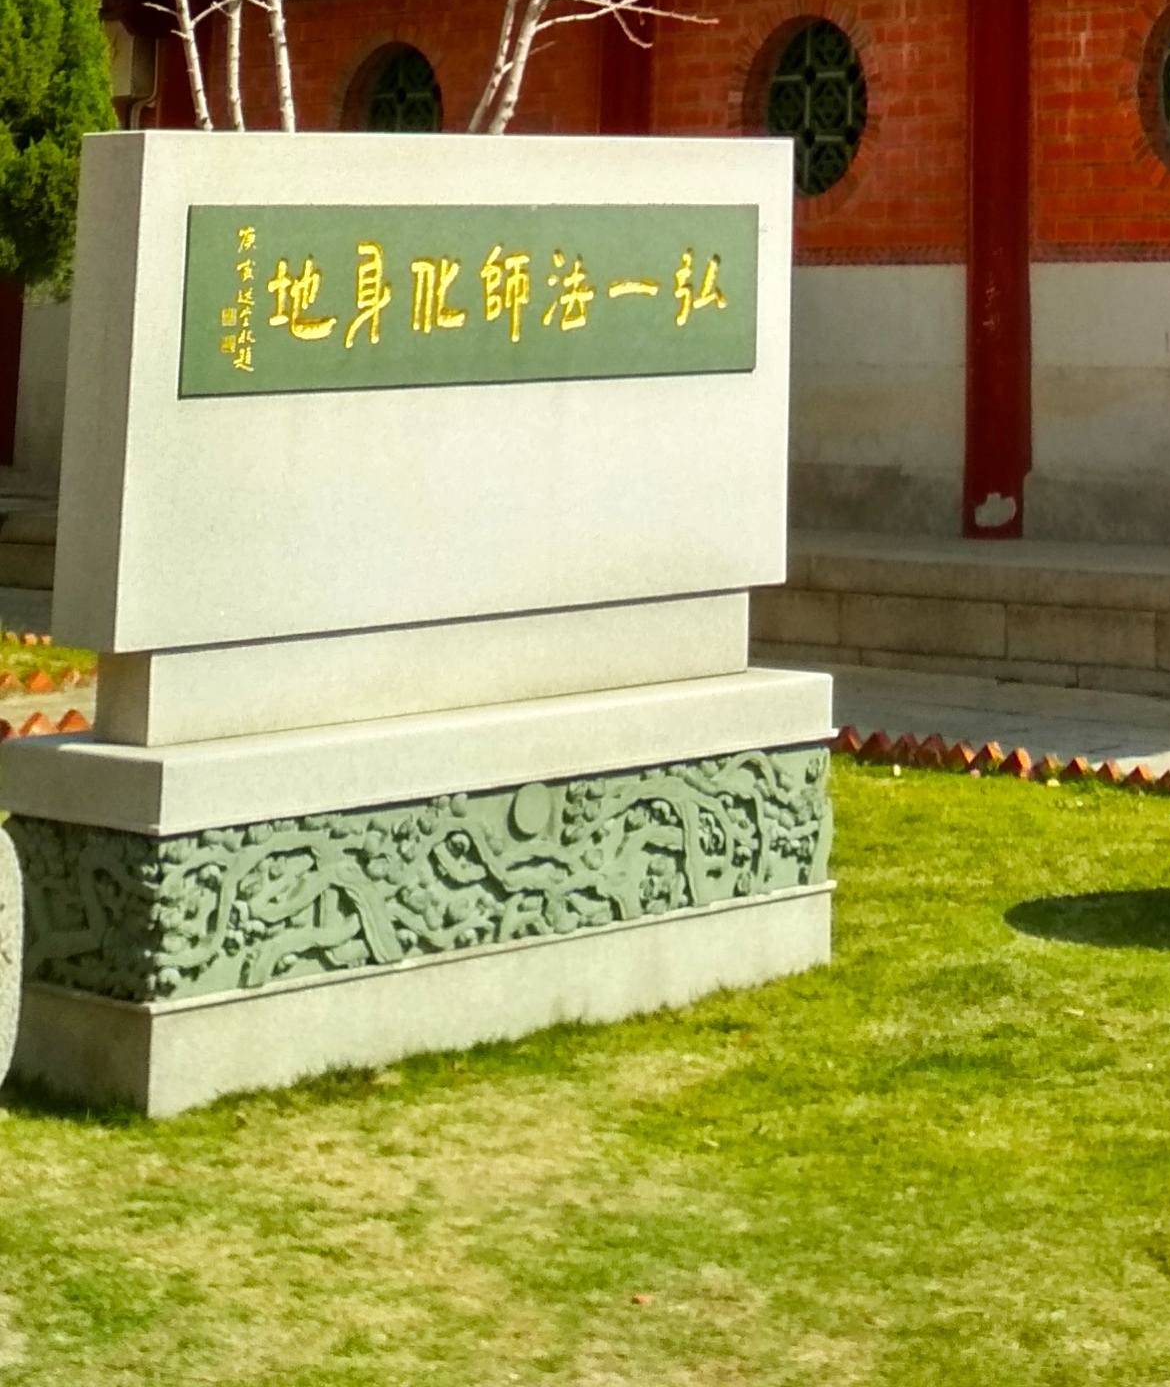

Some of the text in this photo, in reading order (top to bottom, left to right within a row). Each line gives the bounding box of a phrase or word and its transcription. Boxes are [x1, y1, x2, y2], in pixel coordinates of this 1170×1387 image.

[265, 239, 728, 350] 弘一法師化身地
